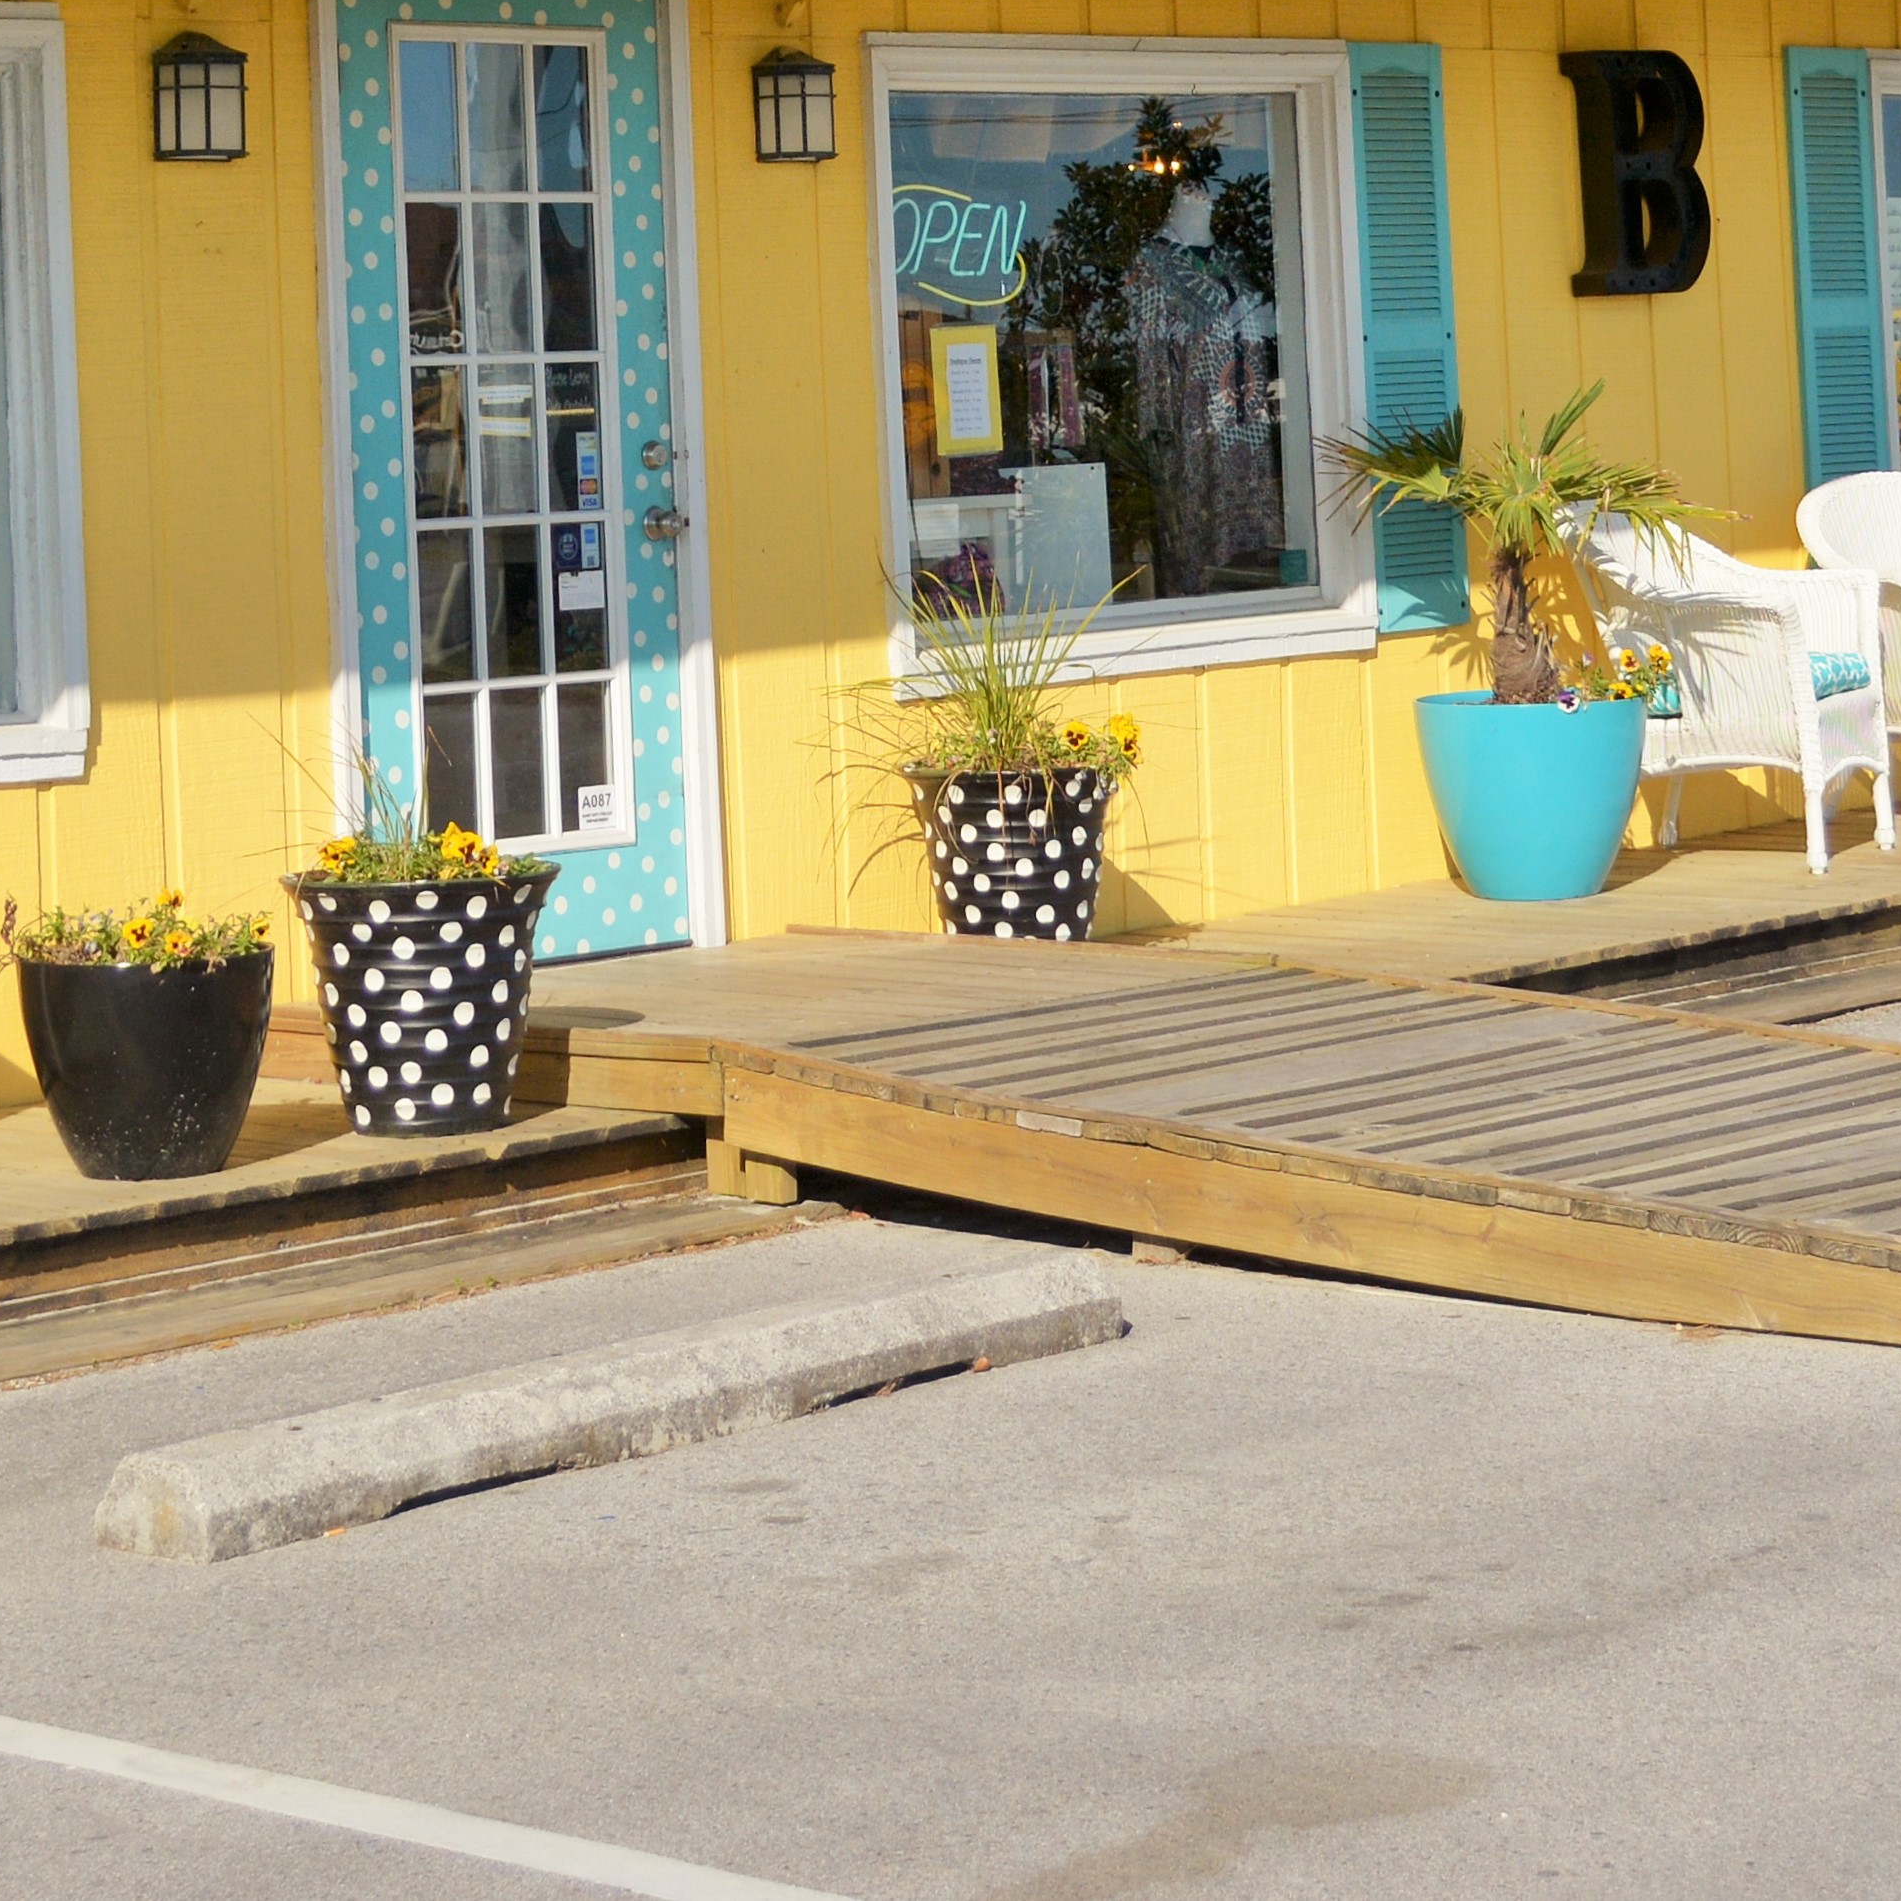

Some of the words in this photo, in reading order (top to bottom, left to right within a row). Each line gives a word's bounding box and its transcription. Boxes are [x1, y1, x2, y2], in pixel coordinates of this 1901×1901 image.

[1558, 50, 1711, 297] B
[893, 198, 1027, 276] OPEN
[582, 792, 611, 809] A087
